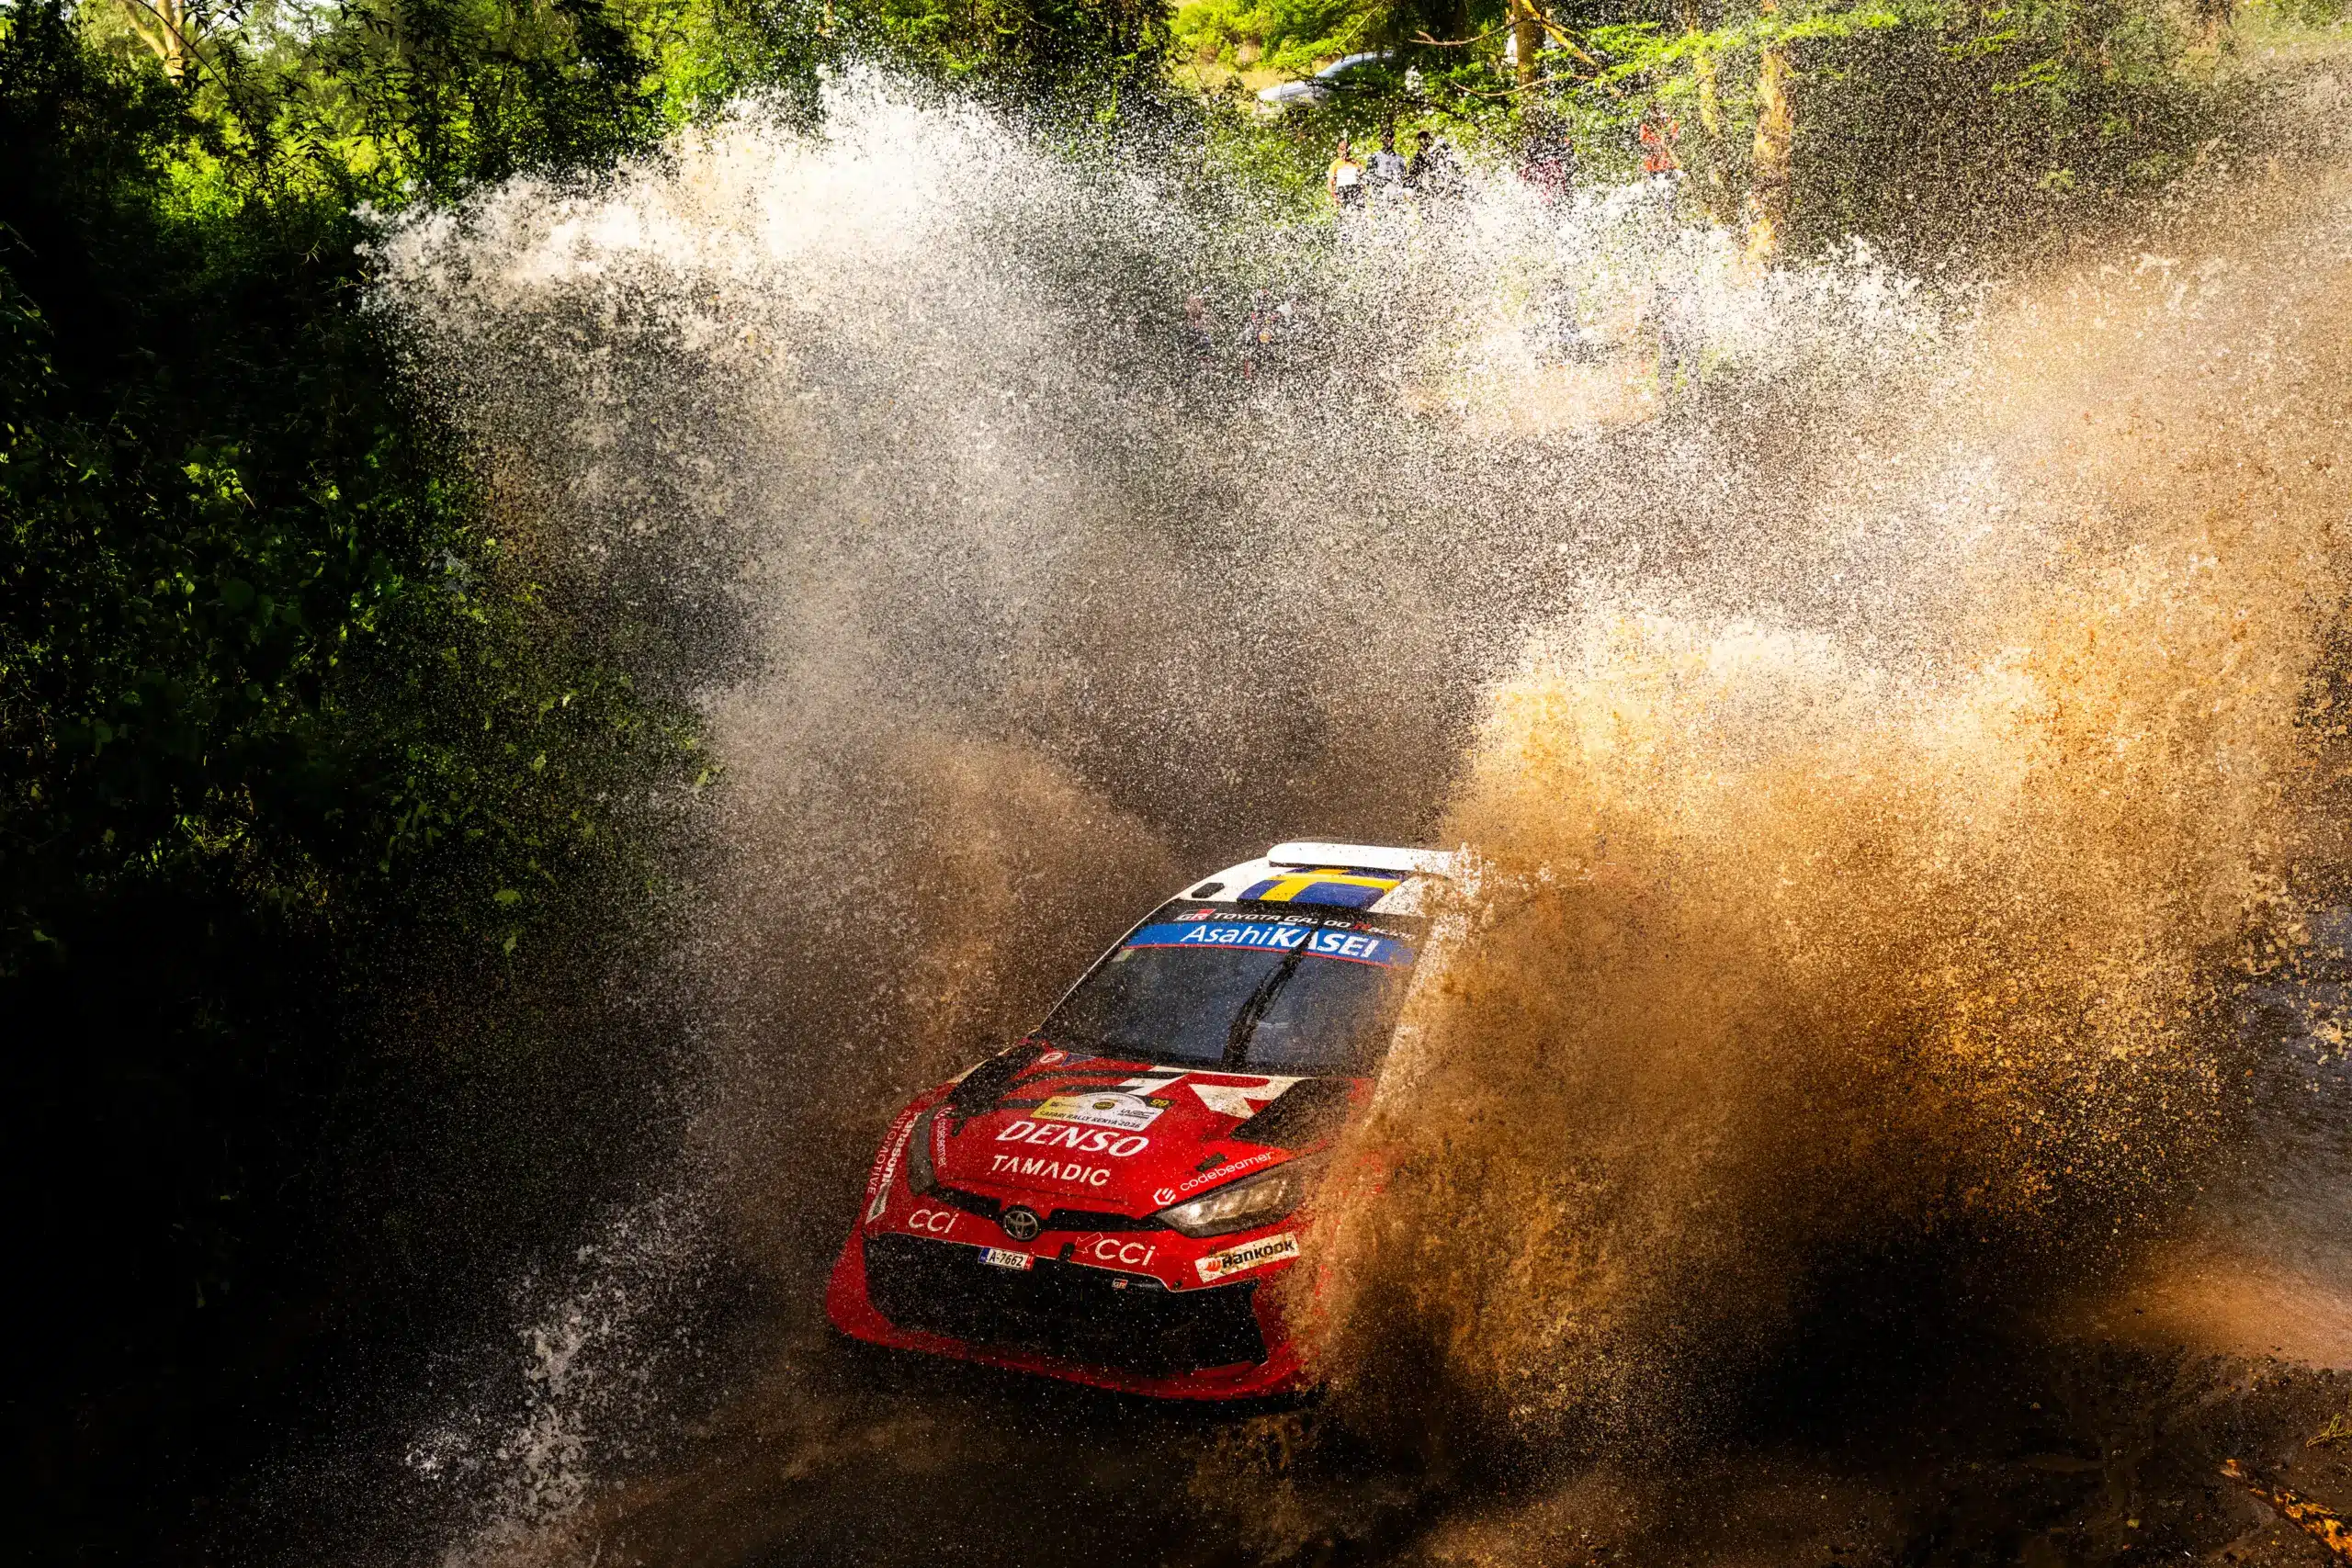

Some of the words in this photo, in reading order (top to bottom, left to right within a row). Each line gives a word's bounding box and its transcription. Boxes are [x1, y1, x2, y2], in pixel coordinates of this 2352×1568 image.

[1214, 912, 1279, 921] TOYOTA
[1278, 916, 1351, 929] GAOO
[1150, 1099, 1170, 1107] 99
[1066, 1113, 1091, 1122] RALLY
[1091, 1116, 1118, 1125] KENYA
[995, 1121, 1149, 1157] DENSO
[991, 1155, 1110, 1186] TAMADIC
[1180, 1151, 1275, 1191] codebeamer
[989, 1251, 1024, 1267] A-7662
[1222, 1240, 1295, 1268] Hankook
